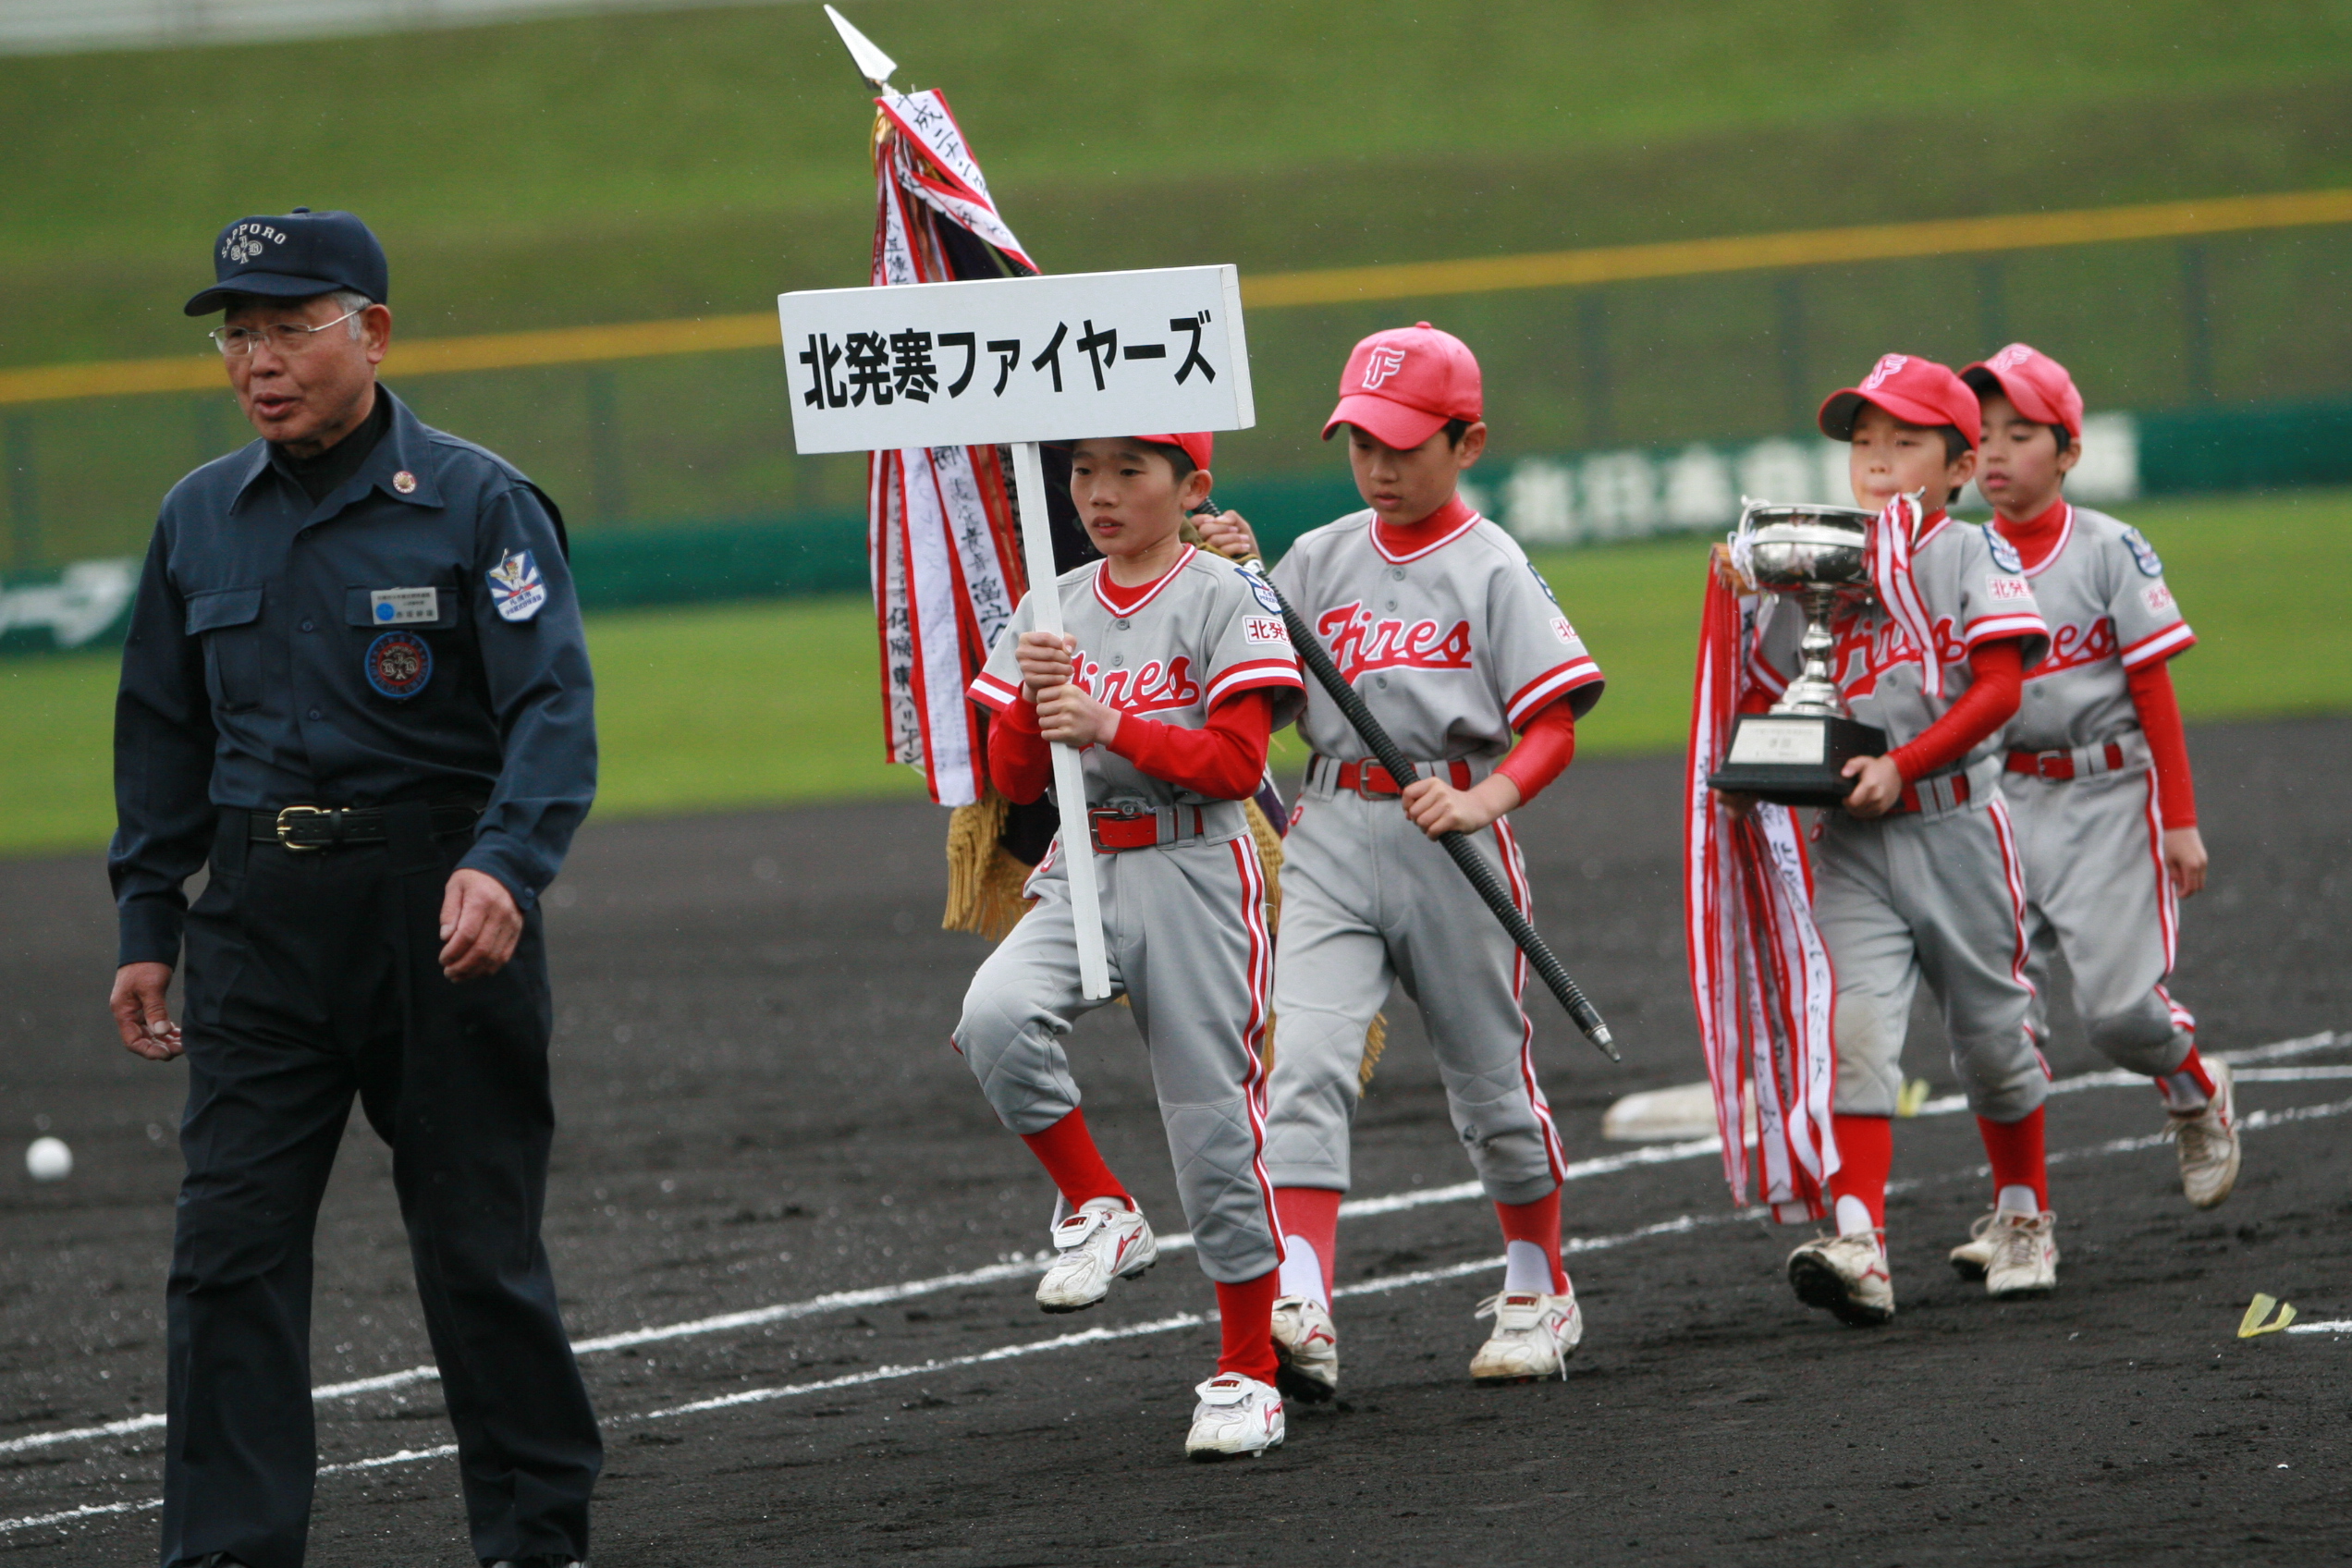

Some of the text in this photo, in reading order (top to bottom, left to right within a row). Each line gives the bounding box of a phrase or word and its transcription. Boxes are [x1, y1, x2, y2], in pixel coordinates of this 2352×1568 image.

[222, 223, 288, 258] SAPPORO
[799, 310, 1217, 410] 北発寒ファイヤーズ
[1362, 347, 1406, 390] F
[1991, 579, 2033, 599] 北発
[1248, 619, 1292, 642] 北発
[1317, 599, 1473, 685] Fires
[1829, 613, 1969, 702] Firs
